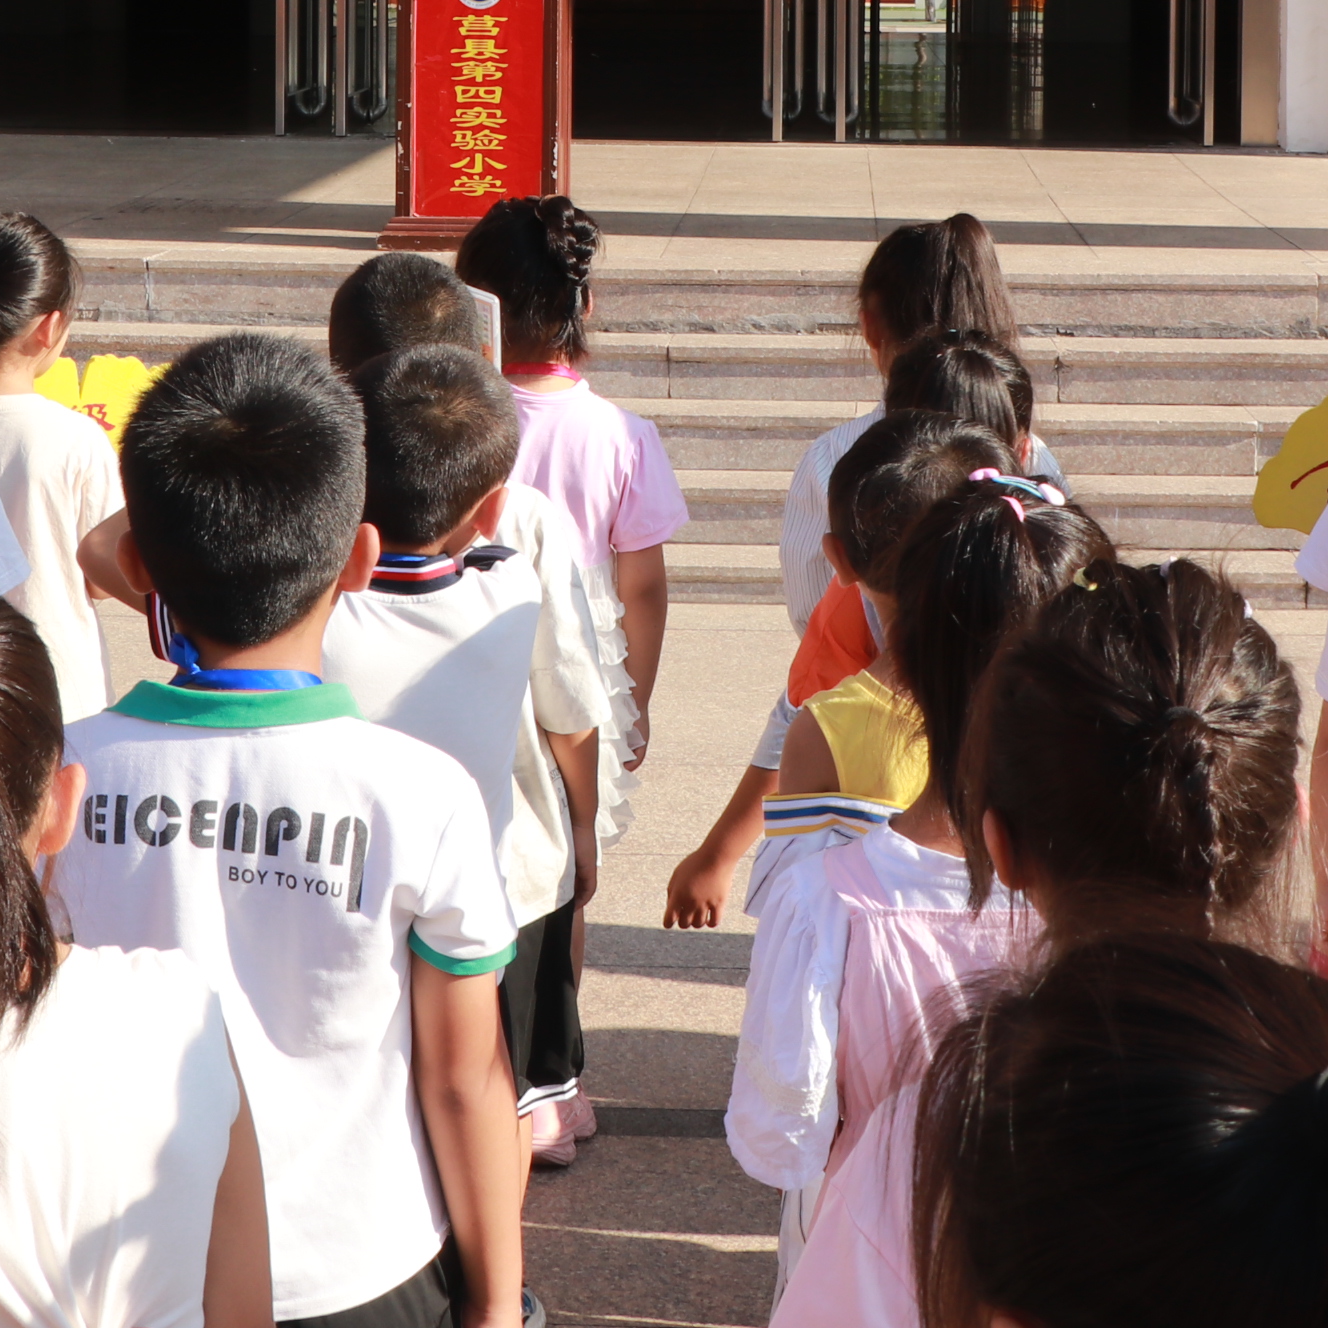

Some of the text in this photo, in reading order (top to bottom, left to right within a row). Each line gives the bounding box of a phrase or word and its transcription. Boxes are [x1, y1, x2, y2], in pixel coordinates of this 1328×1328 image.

[449, 14, 509, 197] 莒县第四实验小学
[228, 866, 343, 898] BOY TO YOU
